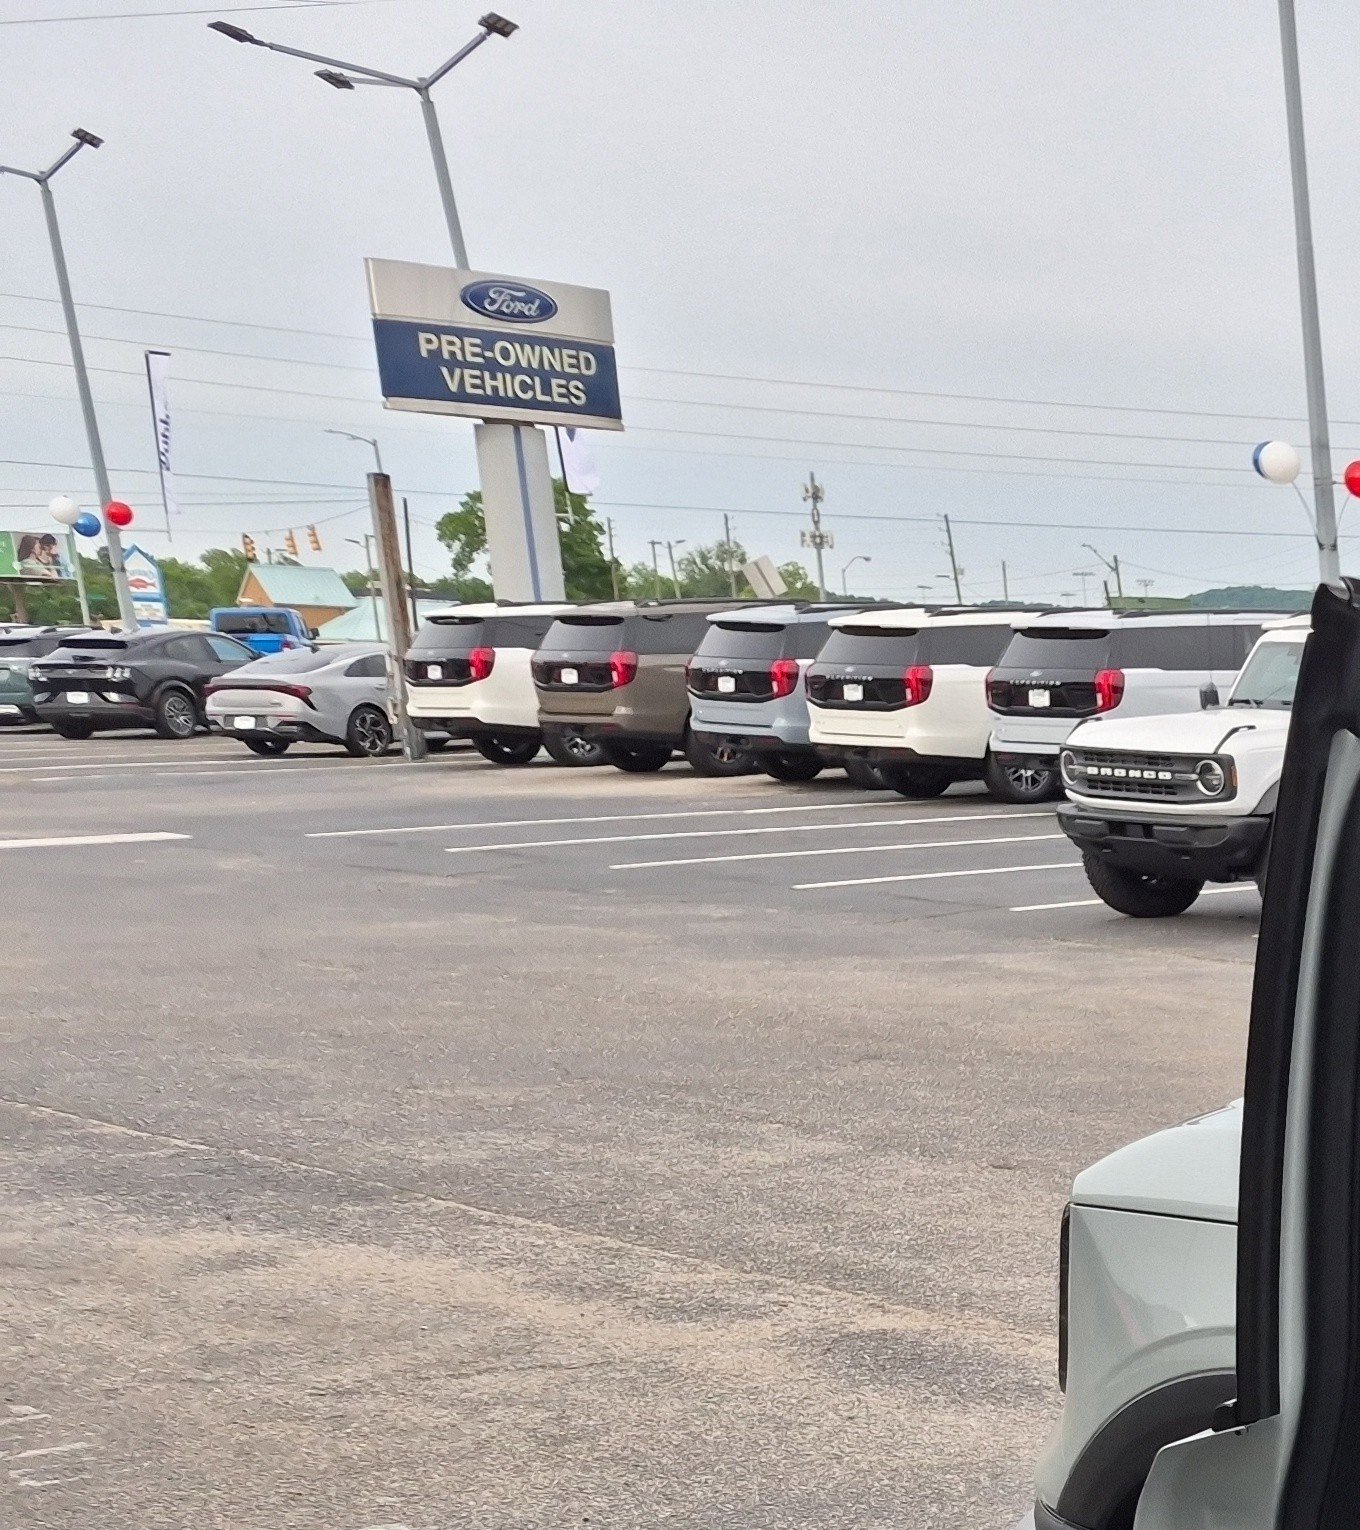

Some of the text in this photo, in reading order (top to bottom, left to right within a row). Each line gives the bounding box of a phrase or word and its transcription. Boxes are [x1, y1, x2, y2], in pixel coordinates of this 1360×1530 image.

[484, 287, 541, 317] Ford
[418, 332, 597, 376] PRE-OWNED
[440, 366, 587, 406] VEHICLES
[1086, 766, 1172, 780] BRONCO
